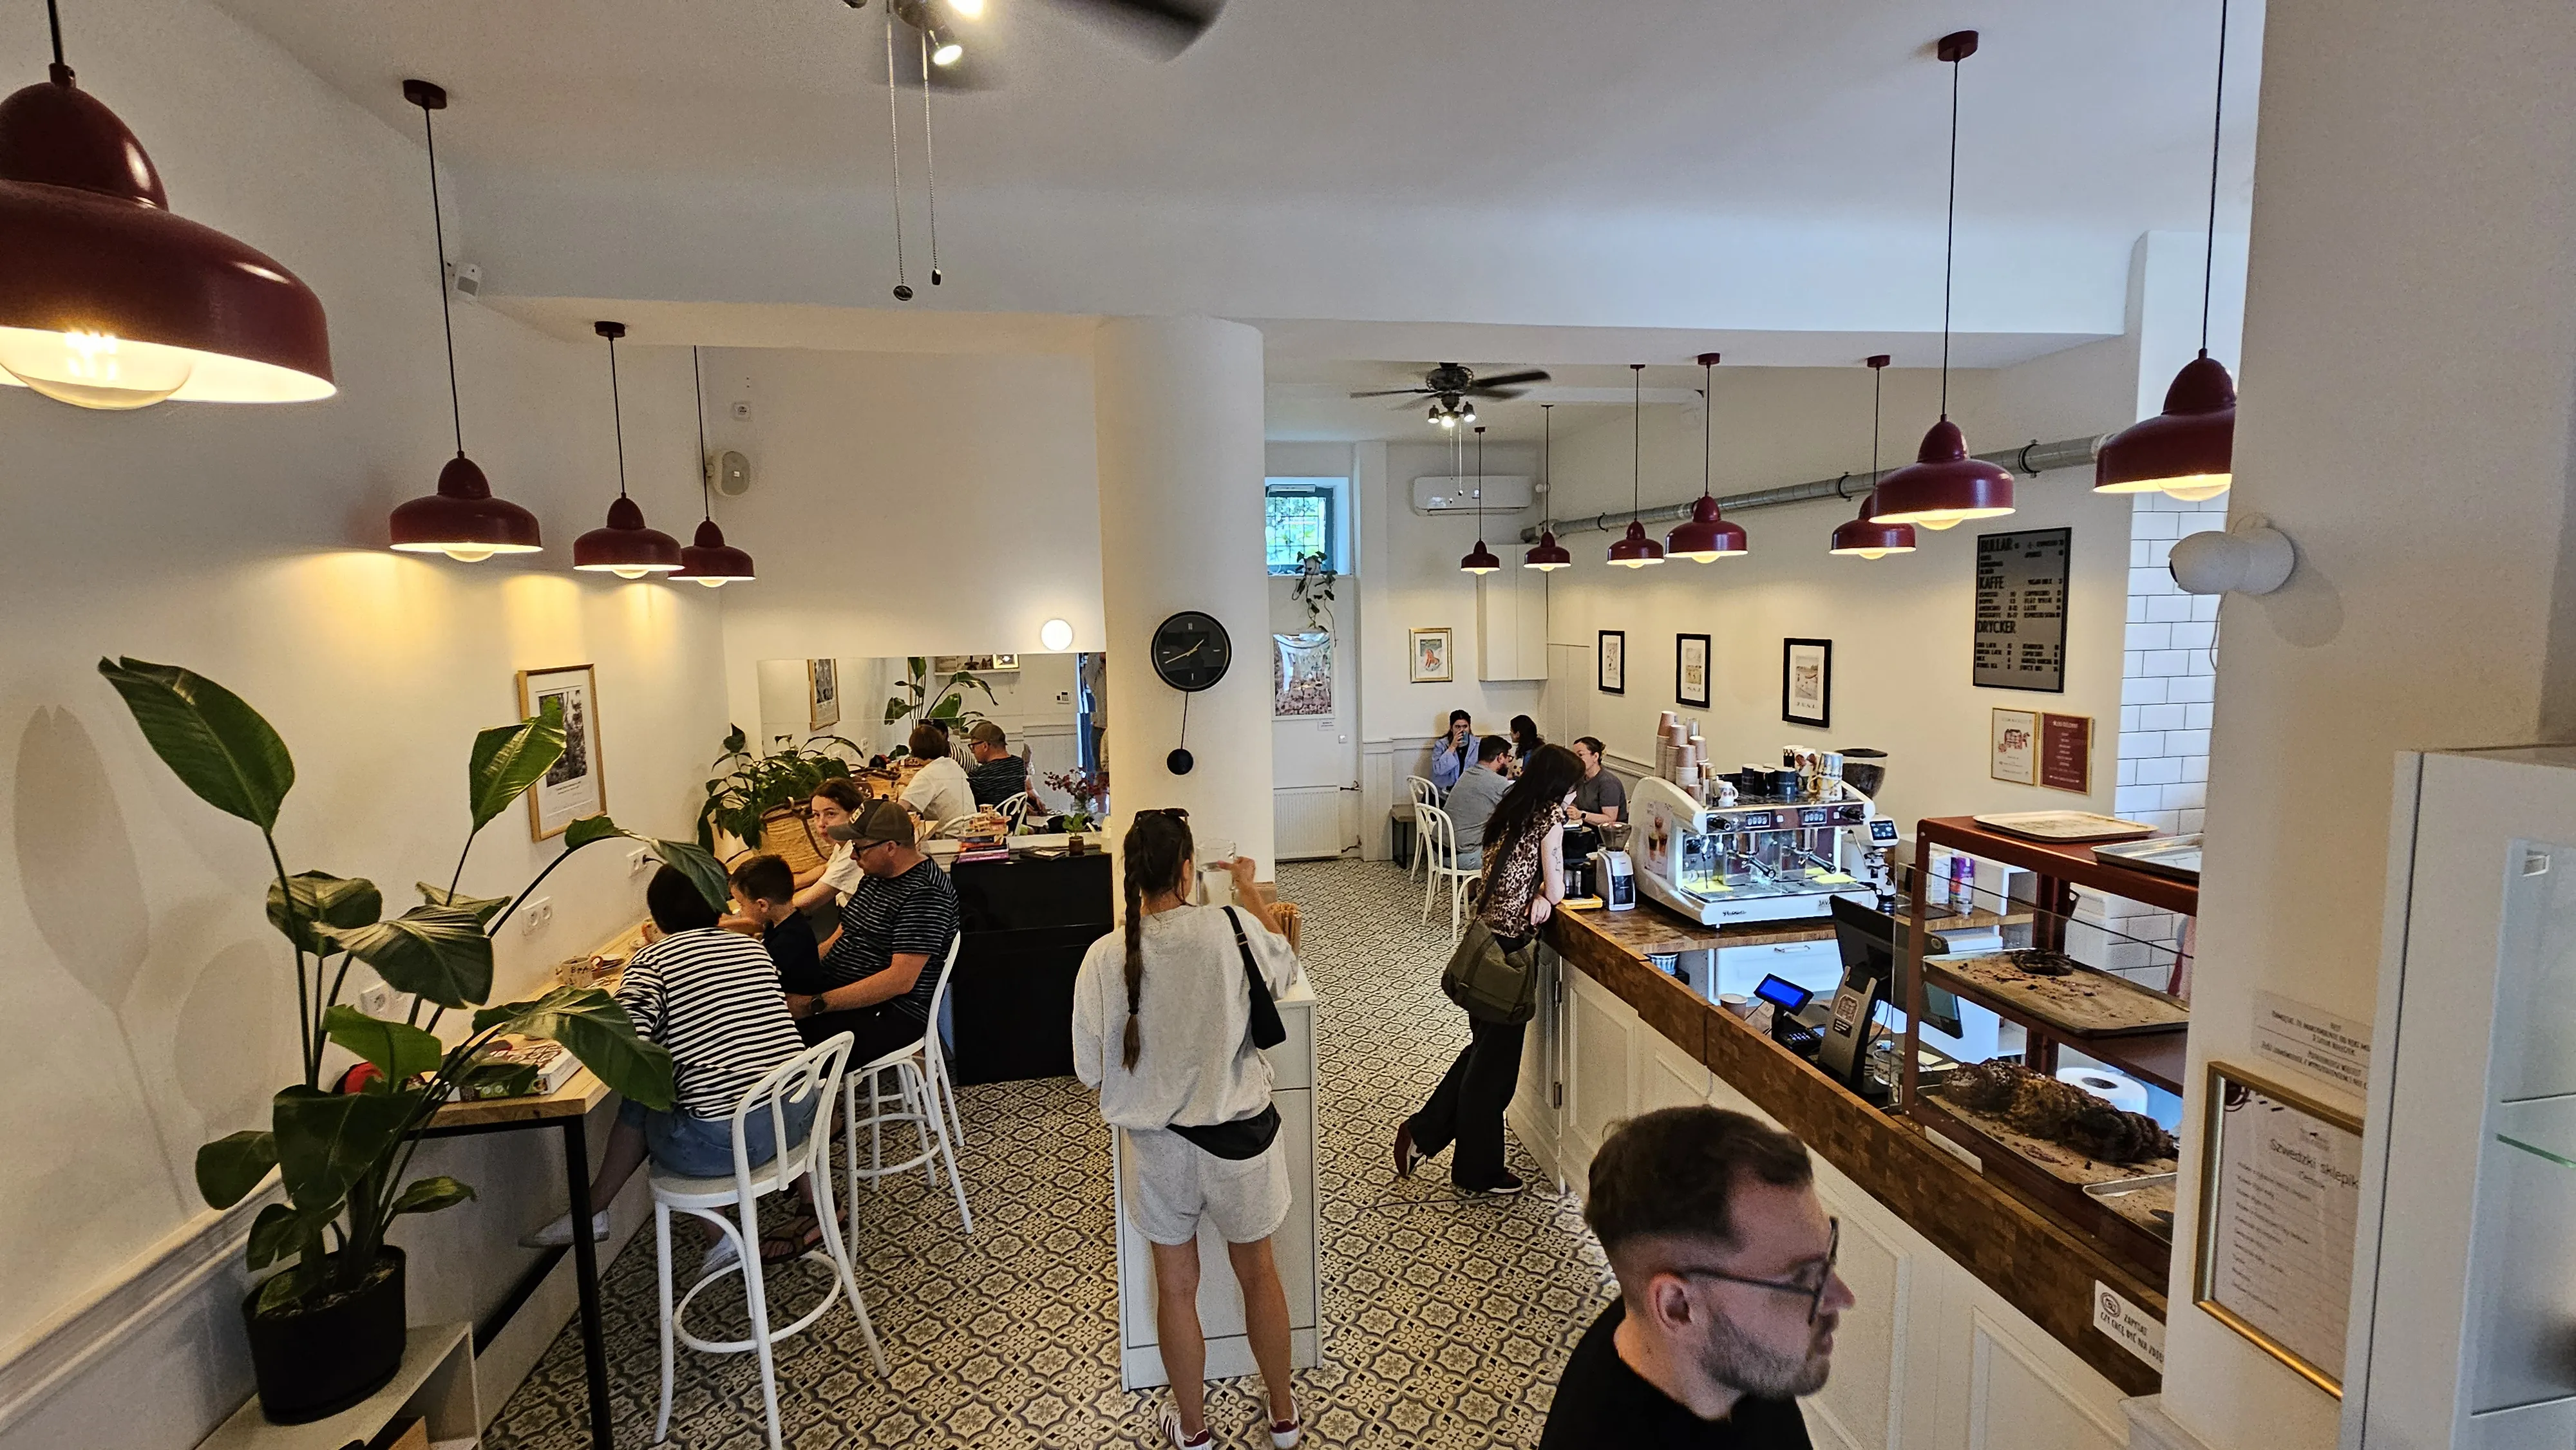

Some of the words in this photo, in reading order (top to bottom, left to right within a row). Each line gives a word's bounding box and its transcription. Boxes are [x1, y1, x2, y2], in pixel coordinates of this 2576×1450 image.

[1980, 538, 2013, 552] BULLAR
[1979, 576, 2004, 589] KAFFE
[1977, 620, 2016, 634] DRYCKER
[2270, 1138, 2316, 1169] Szwedzki
[2320, 1163, 2359, 1190] sklepik
